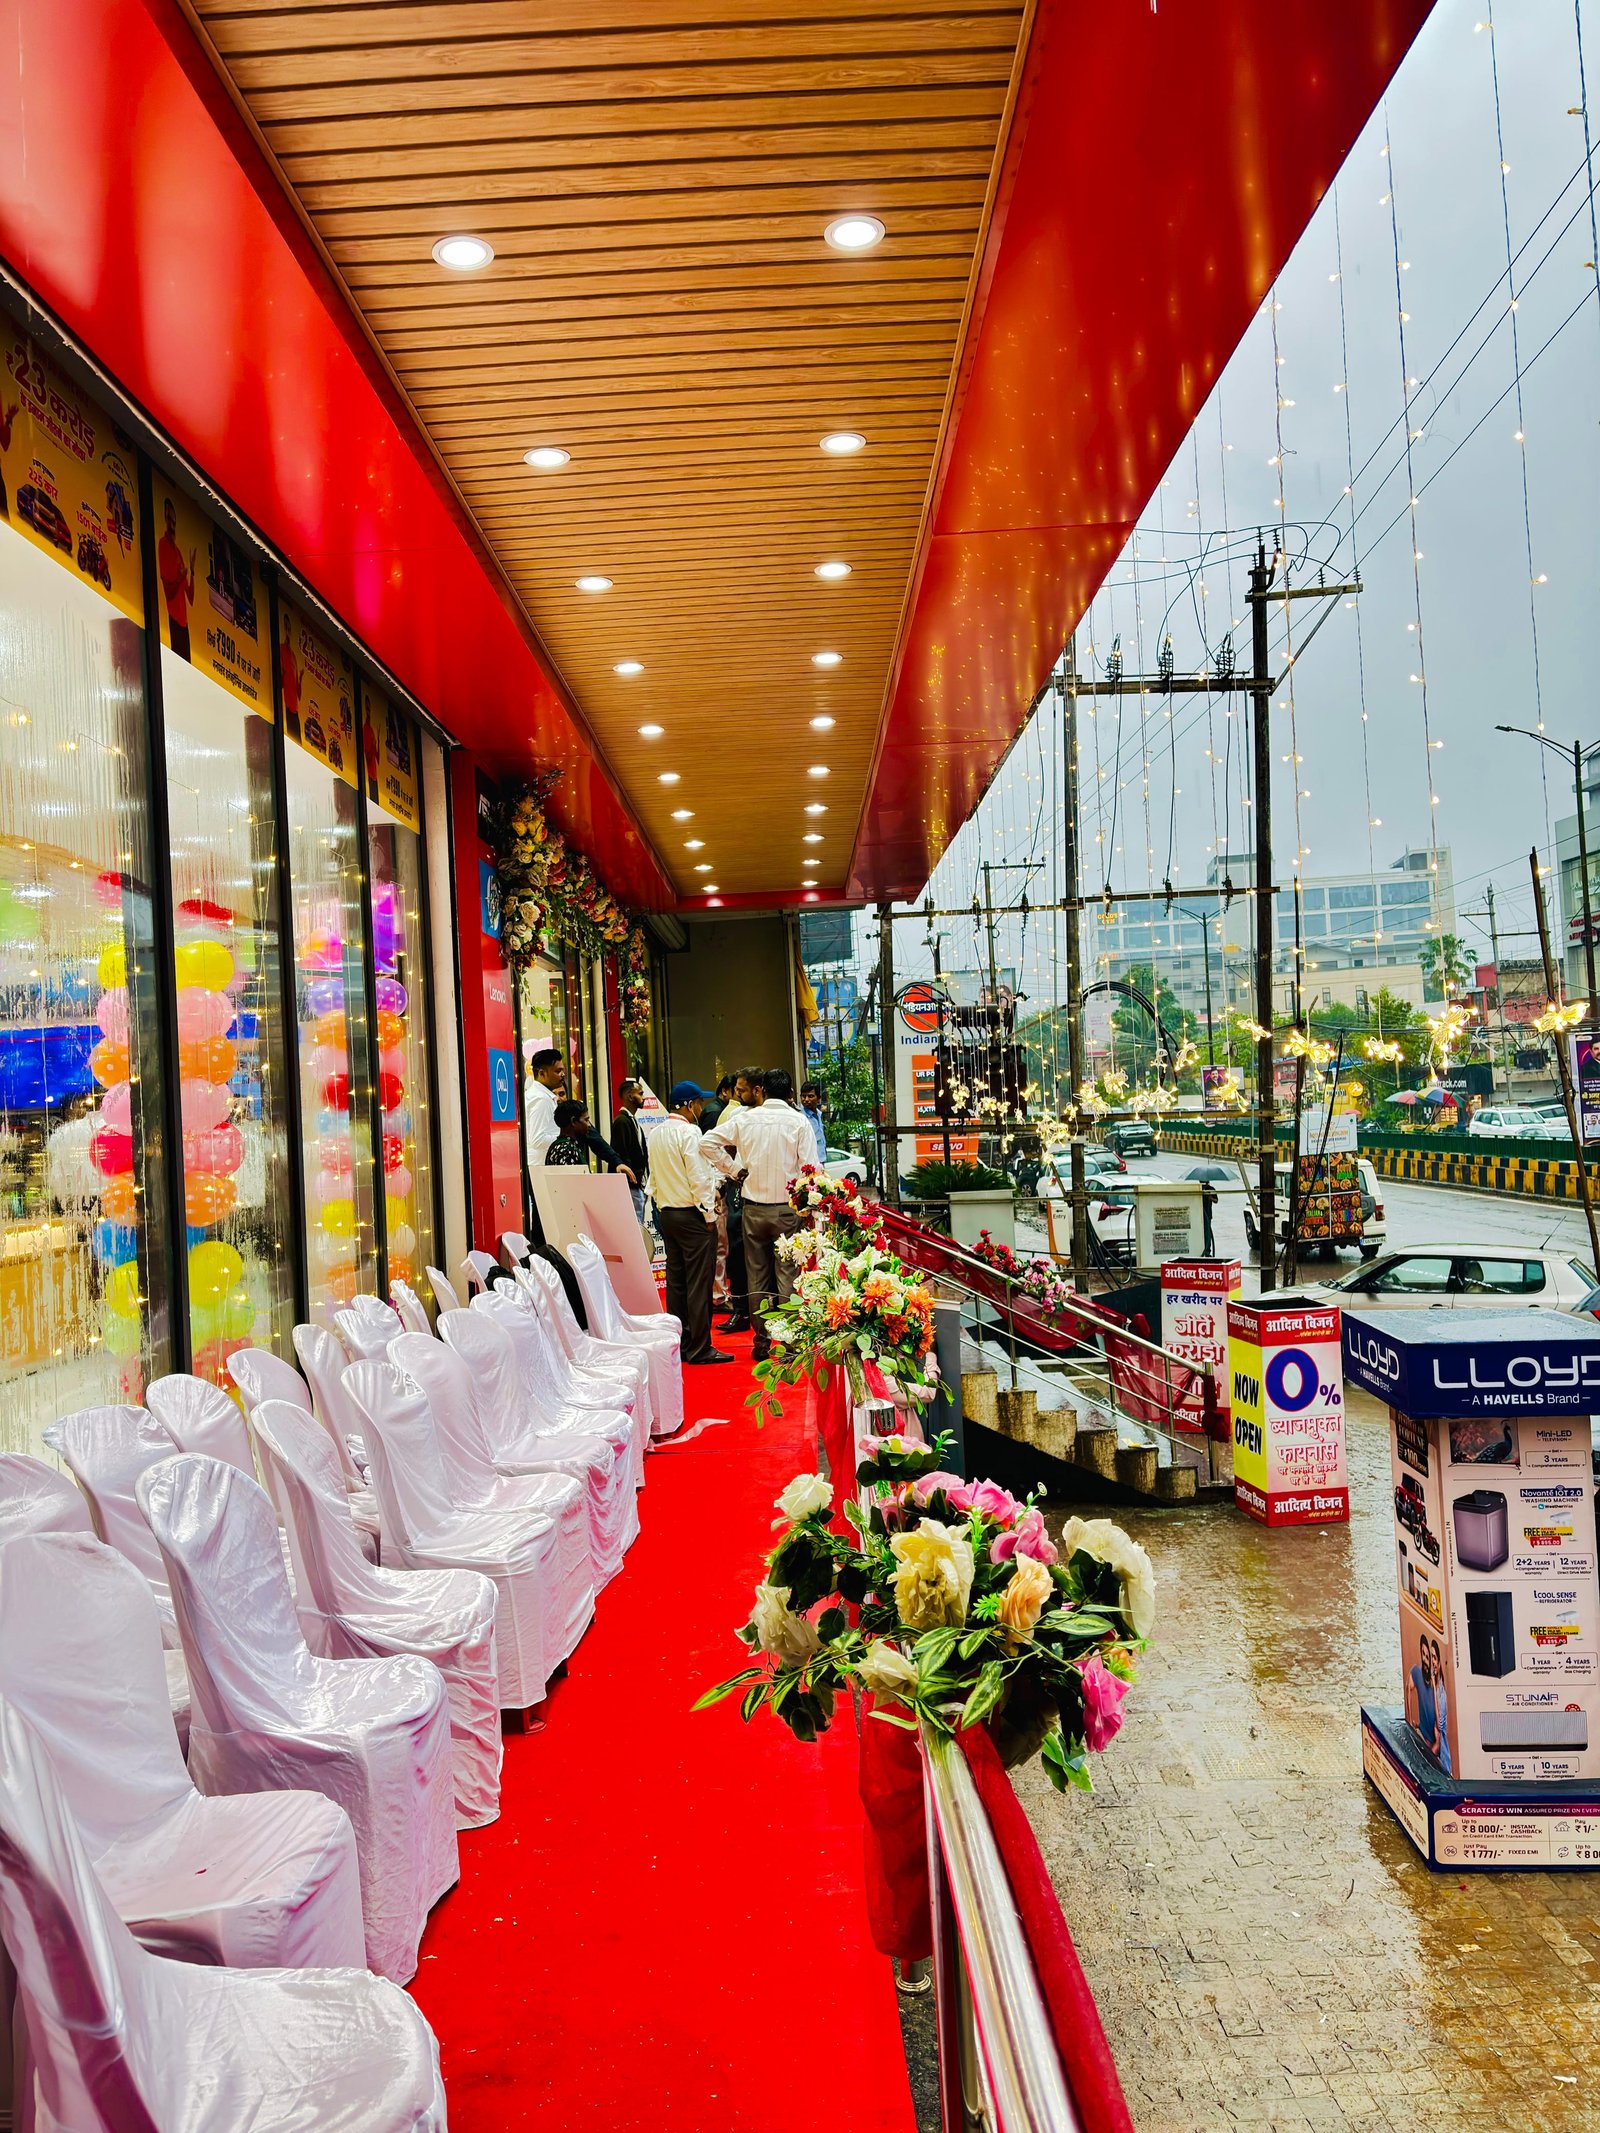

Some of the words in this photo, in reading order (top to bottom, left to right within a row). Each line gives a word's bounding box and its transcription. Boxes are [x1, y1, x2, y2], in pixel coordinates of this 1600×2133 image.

[28, 467, 43, 488] 225
[76, 511, 90, 530] 1501
[217, 627, 236, 664] ₹990
[489, 983, 506, 1004] Lenovo
[931, 1143, 963, 1151] SEVO
[1165, 1267, 1197, 1279] आदित्य
[1198, 1268, 1224, 1280] विजन
[1166, 1293, 1179, 1305] हर
[1181, 1292, 1208, 1306] खरीद
[1209, 1296, 1222, 1306] पर
[1174, 1314, 1215, 1338] जीतें
[1229, 1311, 1245, 1328] आदित्य
[1266, 1316, 1304, 1332] आदित्य
[1305, 1314, 1334, 1329] विजन
[1348, 1328, 1400, 1381] LLOYD
[1363, 1369, 1380, 1387] HAVELLS
[1234, 1371, 1260, 1408] NOW
[1472, 1395, 1480, 1405] A
[1484, 1394, 1544, 1406] HAVELLS
[1547, 1393, 1580, 1404] Brand
[1269, 1413, 1341, 1440] ब्याजमुक्त
[1536, 1430, 1572, 1438] Mini-LED
[1234, 1416, 1262, 1455] OPEN
[1544, 1455, 1550, 1463] 3
[1274, 1498, 1312, 1513] आदित्य
[1314, 1496, 1343, 1510] विजन
[1524, 1527, 1540, 1537] FREE
[1516, 1558, 1532, 1566] 2+2
[1530, 1626, 1546, 1636] FREE
[1532, 1657, 1535, 1665] 1
[1566, 1657, 1572, 1665] 4
[1500, 1762, 1506, 1770] 5
